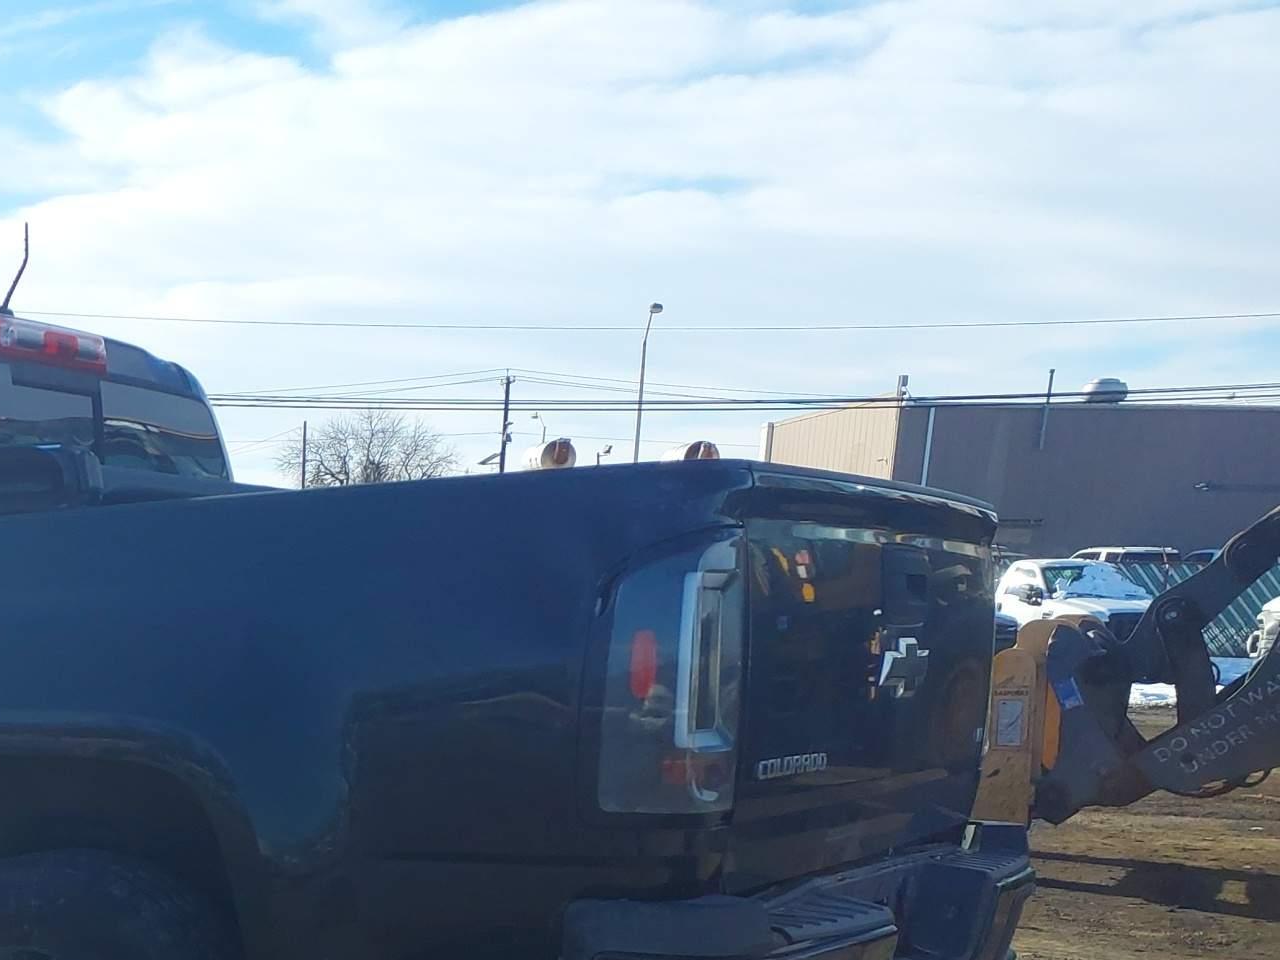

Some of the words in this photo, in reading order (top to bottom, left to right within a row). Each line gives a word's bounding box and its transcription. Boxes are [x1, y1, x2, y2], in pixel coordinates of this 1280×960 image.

[1153, 737, 1188, 762] DO
[1190, 703, 1236, 738] NOT
[1240, 673, 1280, 705] WA
[758, 753, 827, 780] COLORADO
[1181, 724, 1255, 773] UNDER
